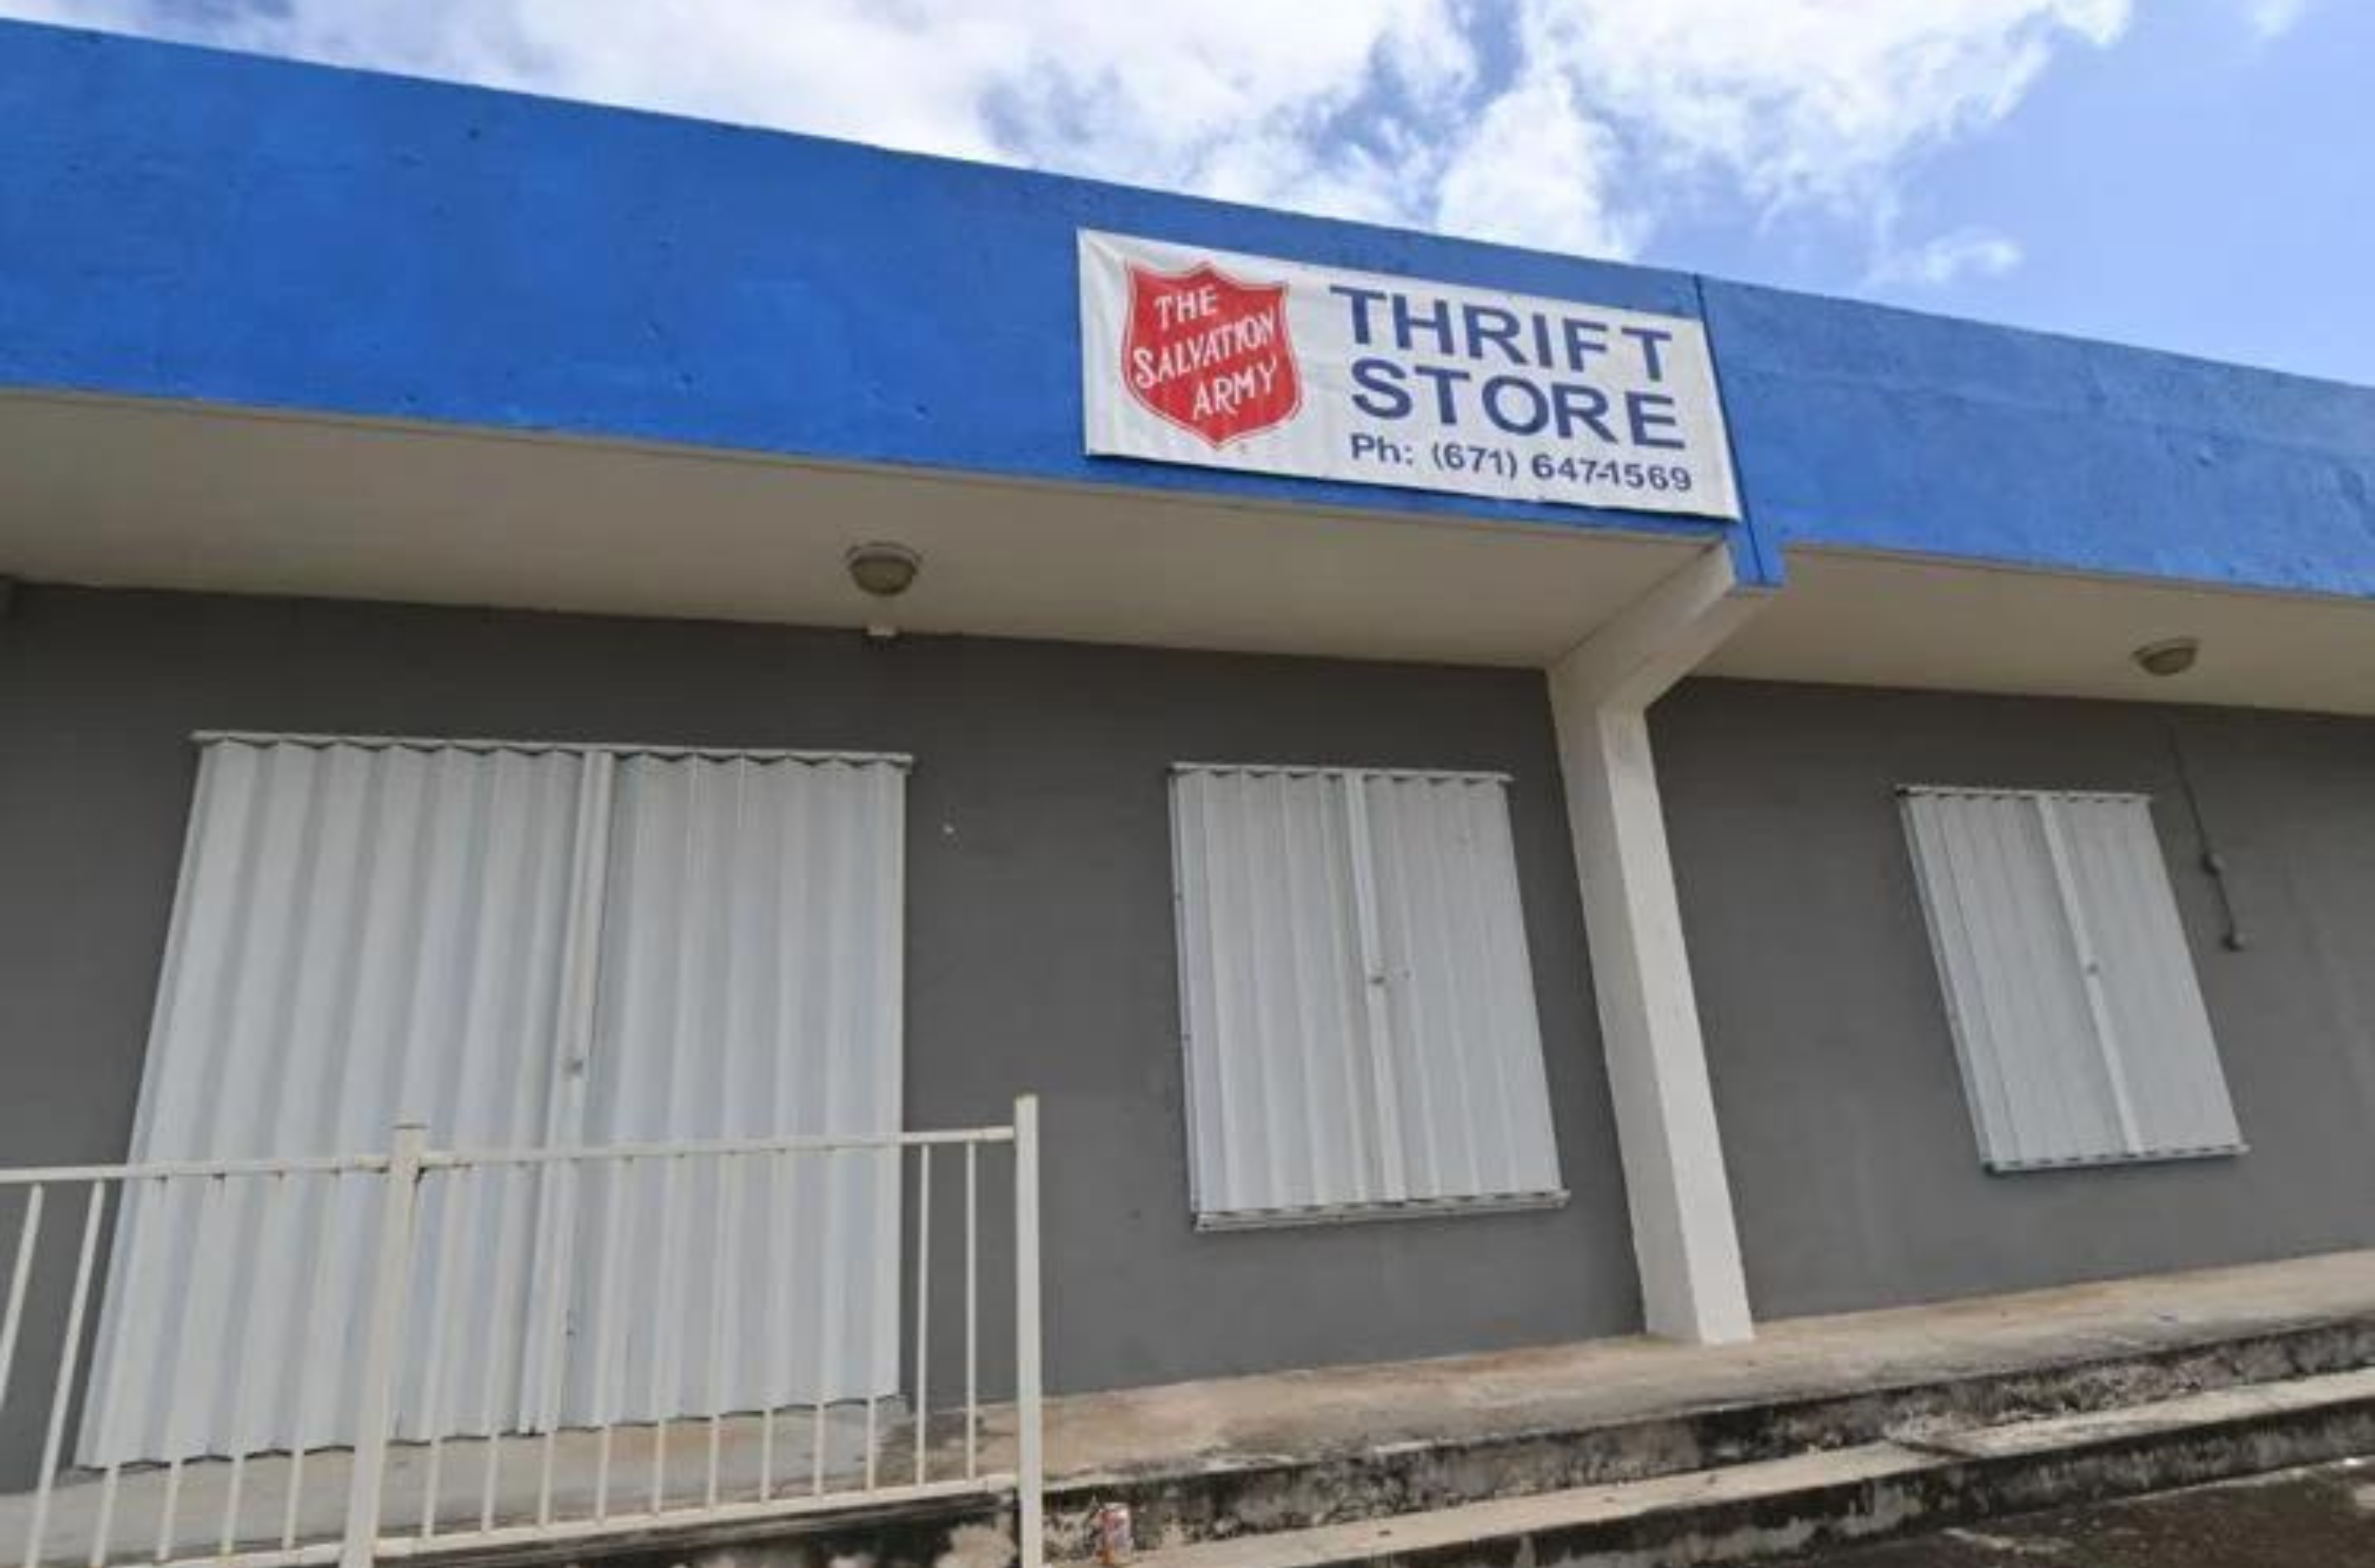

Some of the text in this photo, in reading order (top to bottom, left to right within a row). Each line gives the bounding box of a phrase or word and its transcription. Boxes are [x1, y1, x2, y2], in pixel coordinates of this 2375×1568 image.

[1154, 283, 1219, 333] THE
[1330, 285, 1673, 381] THRIFT
[1133, 306, 1275, 389] SALVATION
[1191, 357, 1276, 421] ARMY
[1351, 358, 1686, 449] STORE
[1351, 434, 1691, 491] Ph: (671) 647-1569
